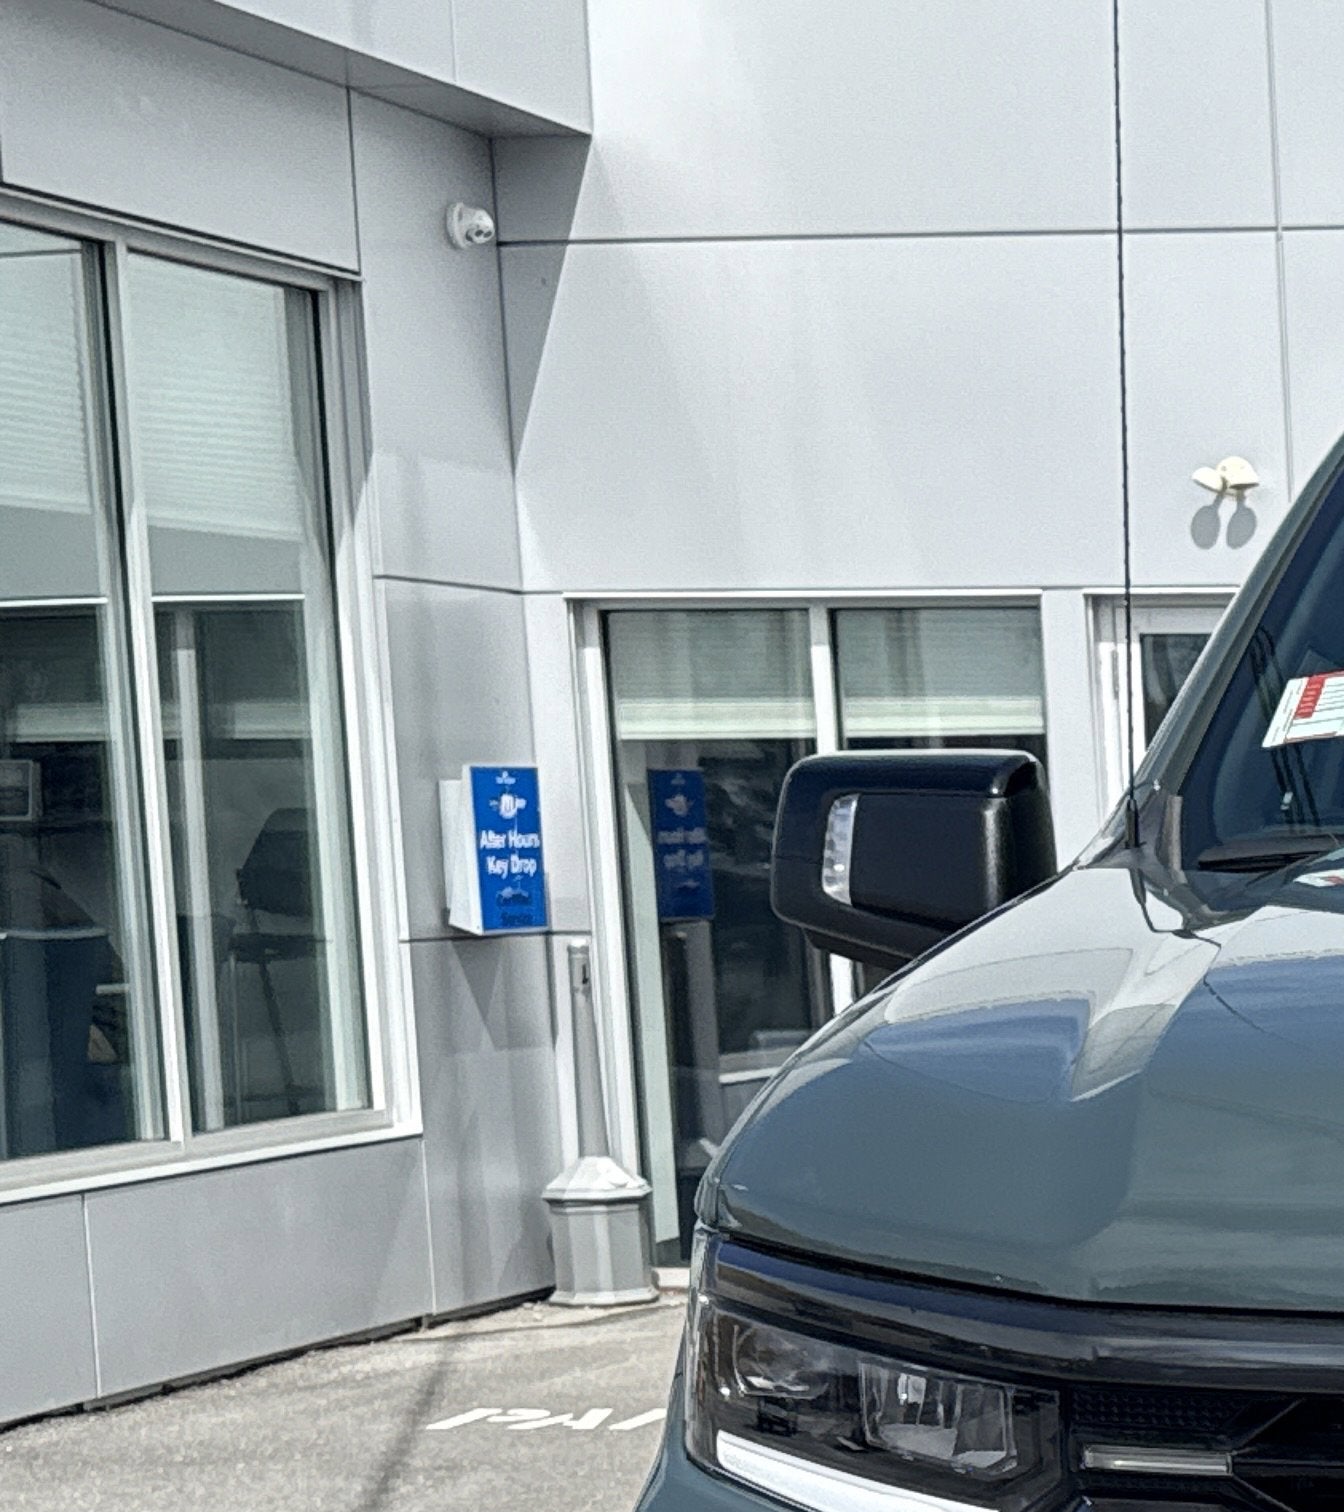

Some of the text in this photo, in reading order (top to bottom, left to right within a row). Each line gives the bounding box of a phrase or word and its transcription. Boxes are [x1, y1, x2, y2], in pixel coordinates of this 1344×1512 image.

[480, 829, 540, 849] After Hours
[486, 854, 537, 879] Key Drop
